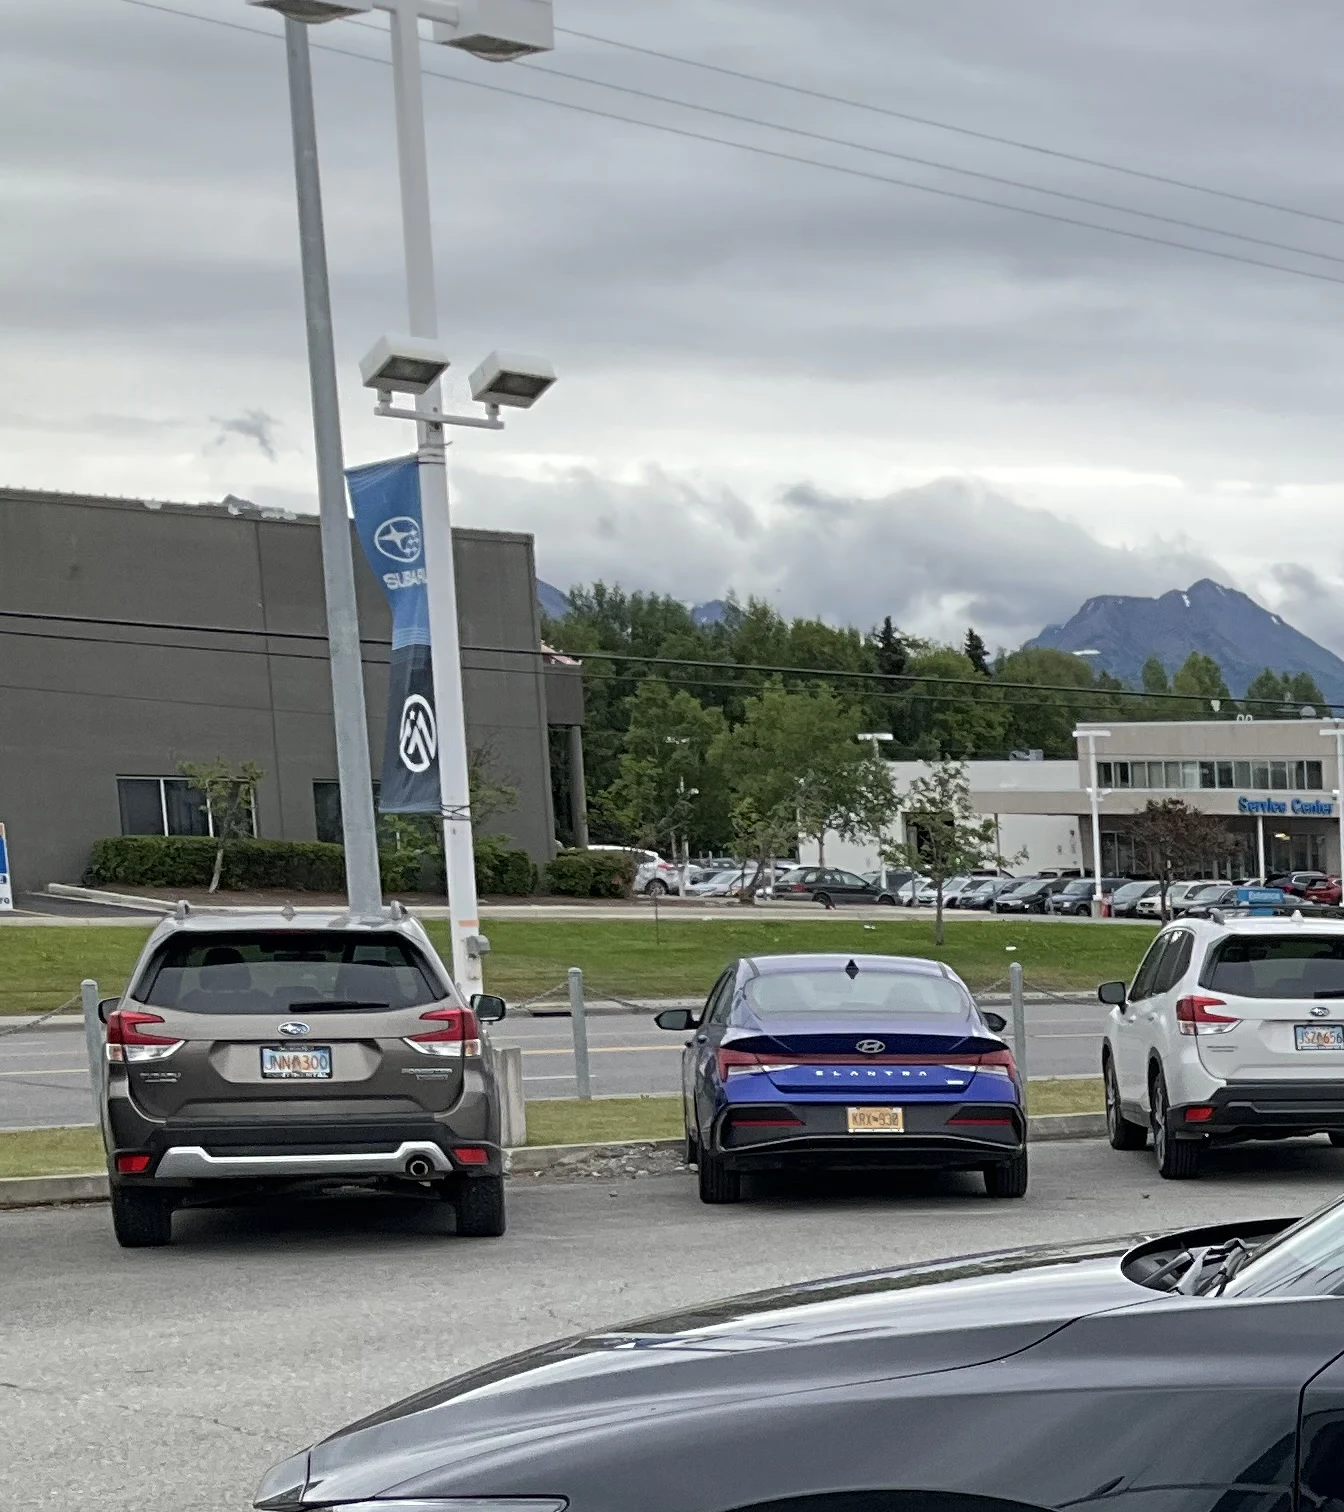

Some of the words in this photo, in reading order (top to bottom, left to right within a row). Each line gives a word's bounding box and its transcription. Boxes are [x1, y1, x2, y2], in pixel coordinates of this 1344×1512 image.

[383, 568, 428, 590] SUBAR
[1238, 796, 1287, 814] Service
[1291, 798, 1333, 816] Center
